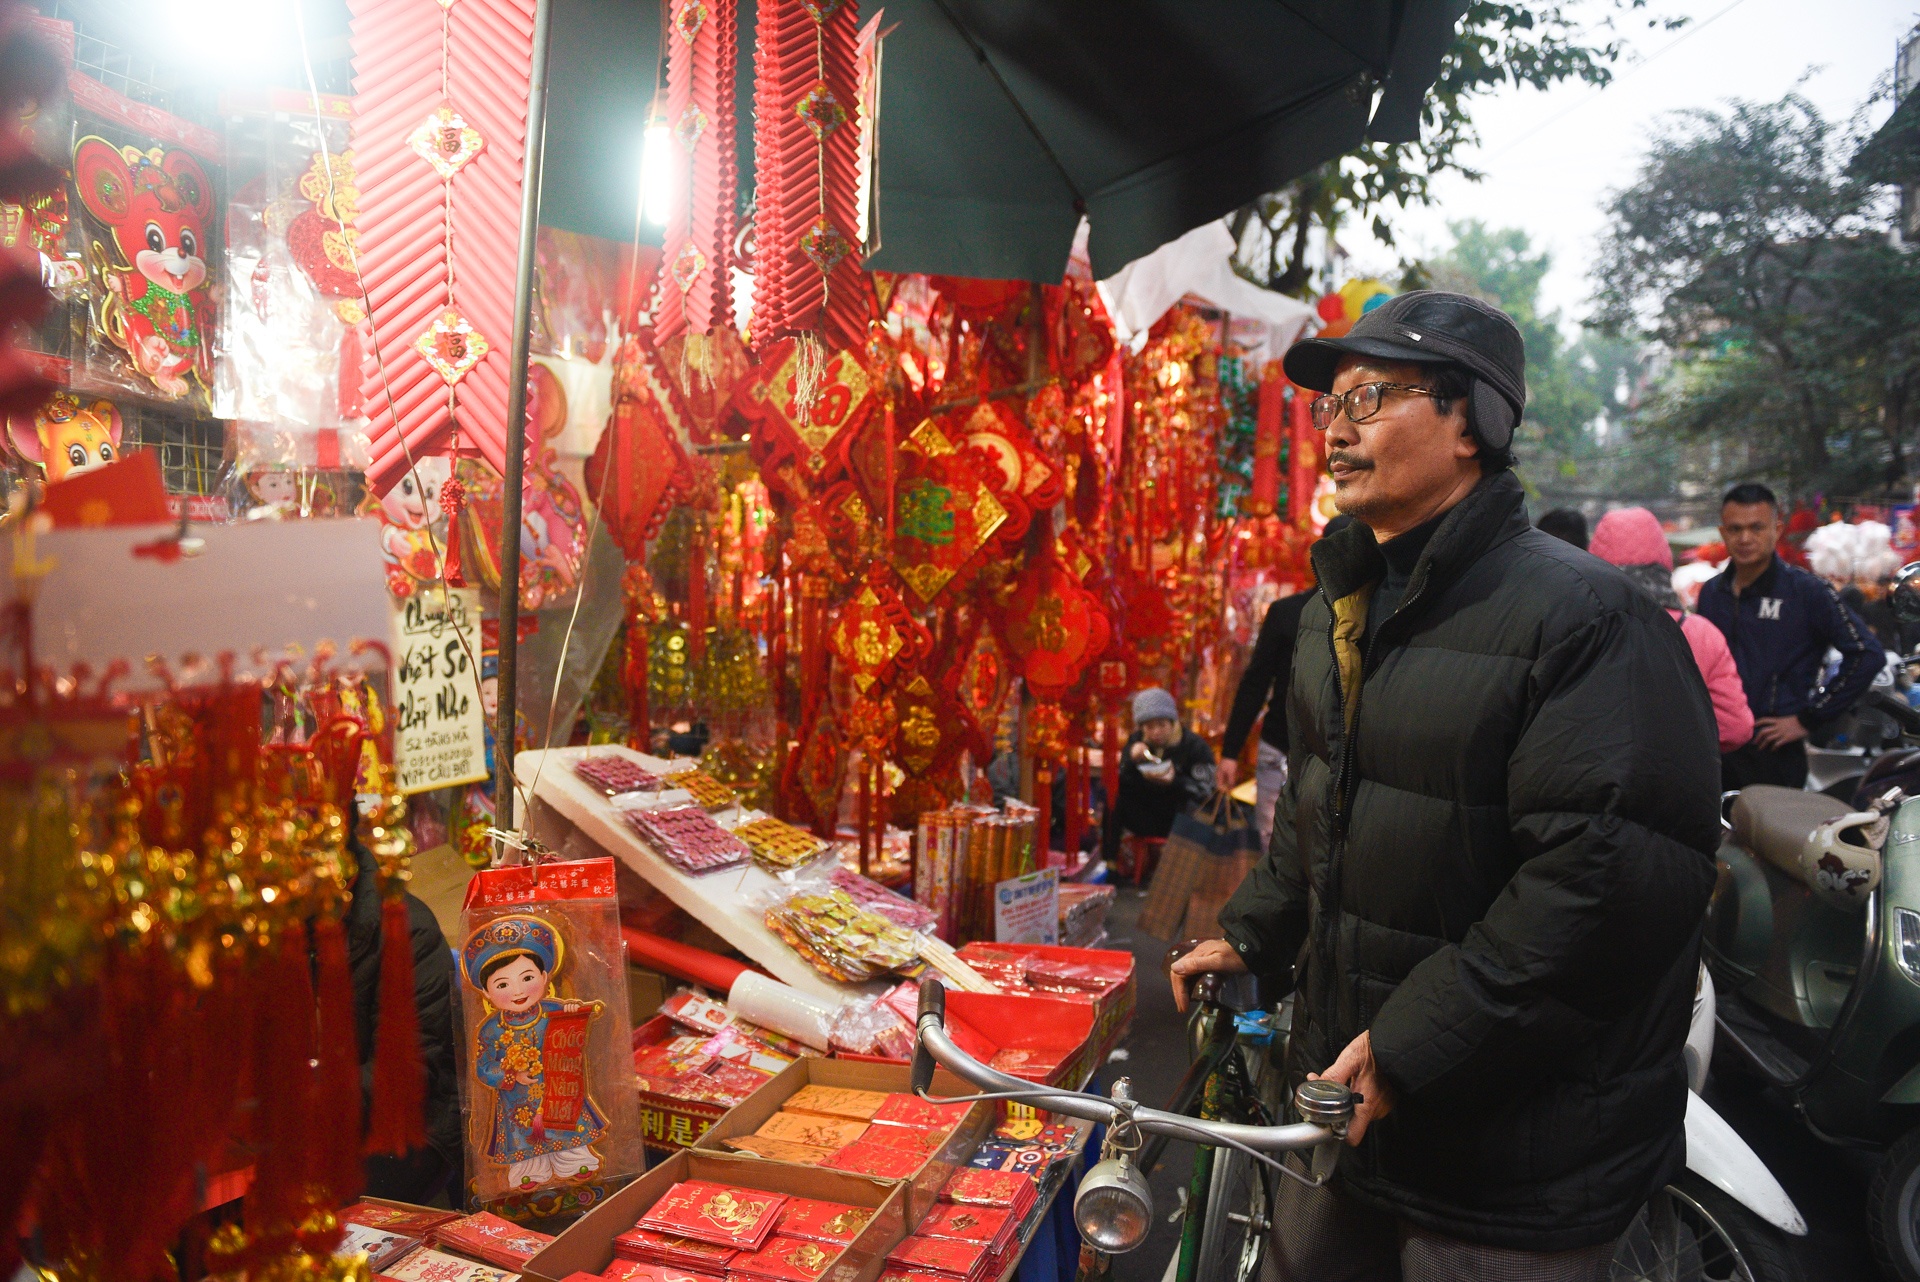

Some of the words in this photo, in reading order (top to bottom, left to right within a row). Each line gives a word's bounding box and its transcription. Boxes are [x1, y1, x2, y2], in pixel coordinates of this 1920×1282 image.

[1757, 597, 1784, 620] M
[548, 1075, 580, 1098] Năm
[640, 1109, 711, 1147] 利是
